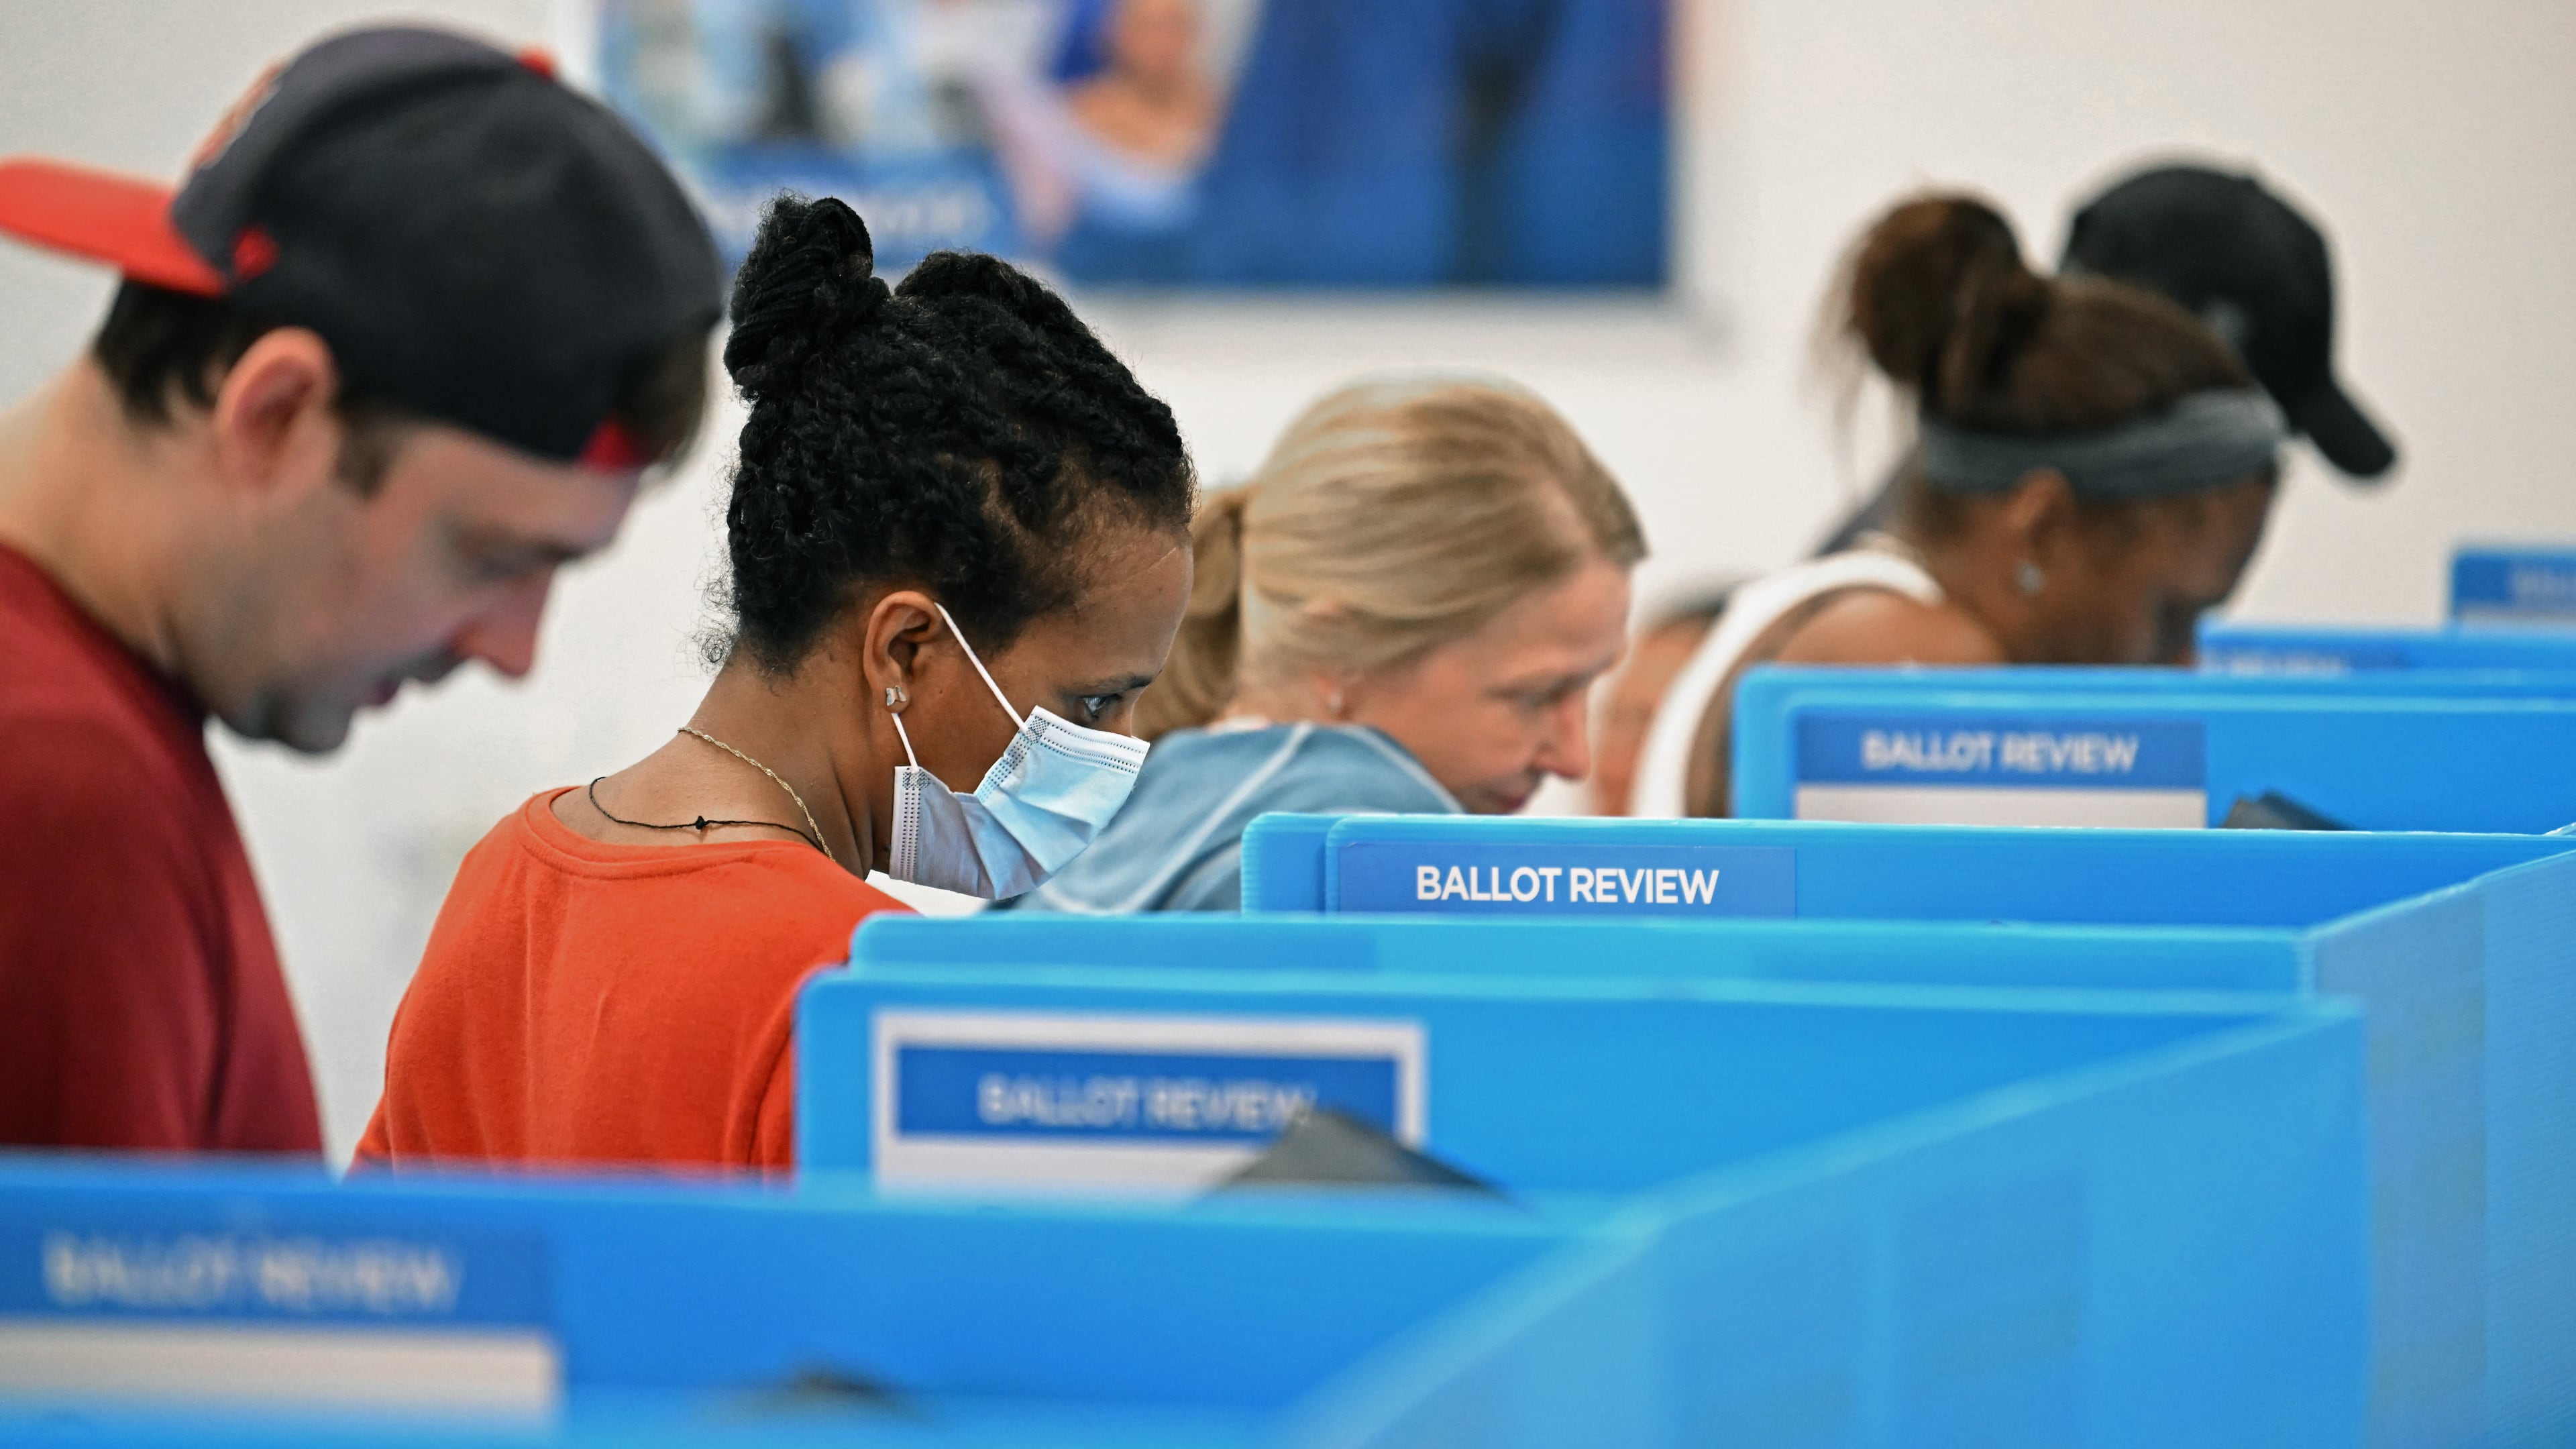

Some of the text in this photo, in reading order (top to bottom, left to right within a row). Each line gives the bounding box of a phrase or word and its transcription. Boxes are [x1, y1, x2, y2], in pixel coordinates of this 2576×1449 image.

[1862, 731, 2138, 773] BALLOT REVIEW
[1417, 866, 1719, 905] BALLOT REVIEW
[979, 1075, 1137, 1126] BALLOT
